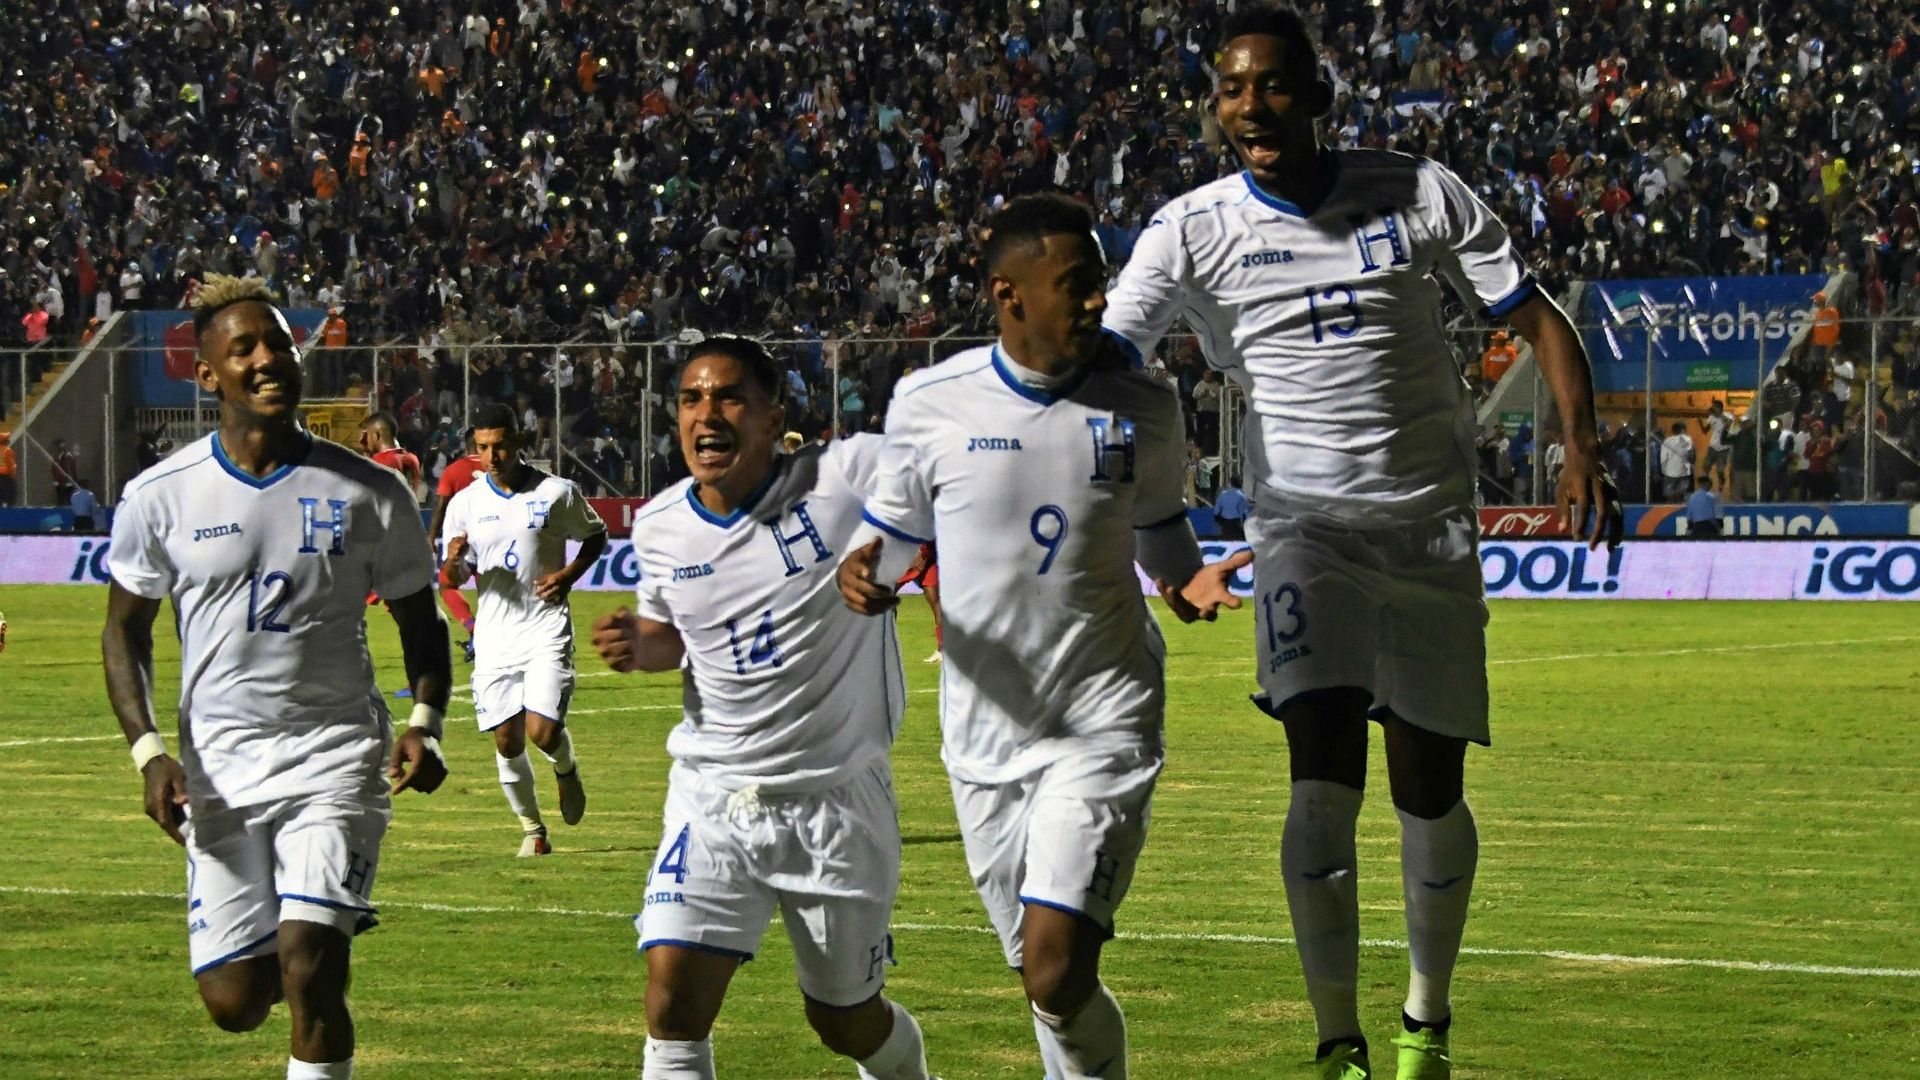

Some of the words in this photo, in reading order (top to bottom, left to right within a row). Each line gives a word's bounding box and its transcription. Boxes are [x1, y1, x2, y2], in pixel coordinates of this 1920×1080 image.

[1305, 283, 1364, 343] 13
[1087, 417, 1137, 484] H
[298, 497, 347, 556] H
[526, 501, 549, 529] H
[764, 500, 834, 577] H
[1030, 504, 1068, 575] 9
[504, 539, 519, 570] 6
[246, 570, 291, 633] 12
[1263, 583, 1308, 653] 13
[726, 609, 783, 676] 14
[341, 851, 371, 895] H
